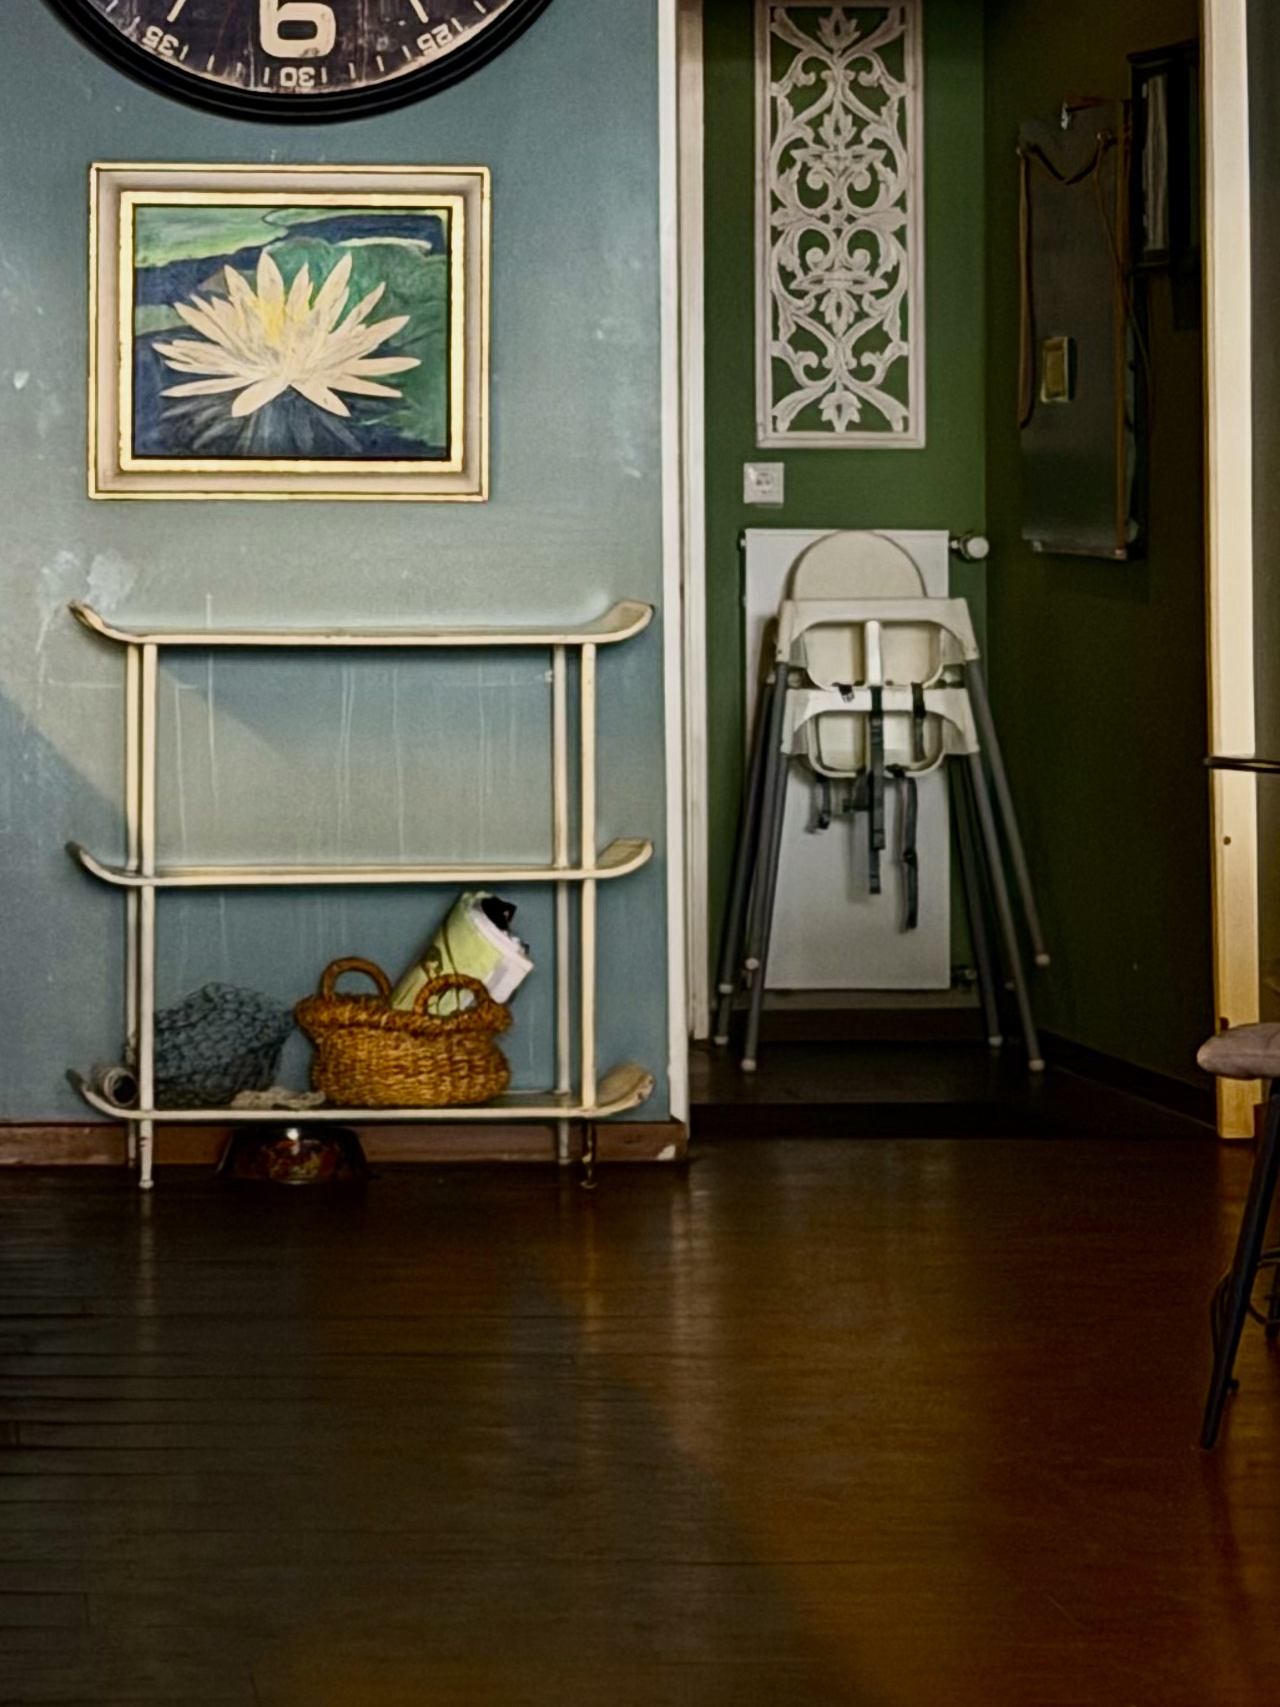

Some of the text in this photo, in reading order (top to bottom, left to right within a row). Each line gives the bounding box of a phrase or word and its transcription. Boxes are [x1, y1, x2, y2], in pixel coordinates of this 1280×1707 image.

[144, 26, 180, 56] 35
[417, 24, 454, 53] 25
[280, 66, 316, 87] 30
